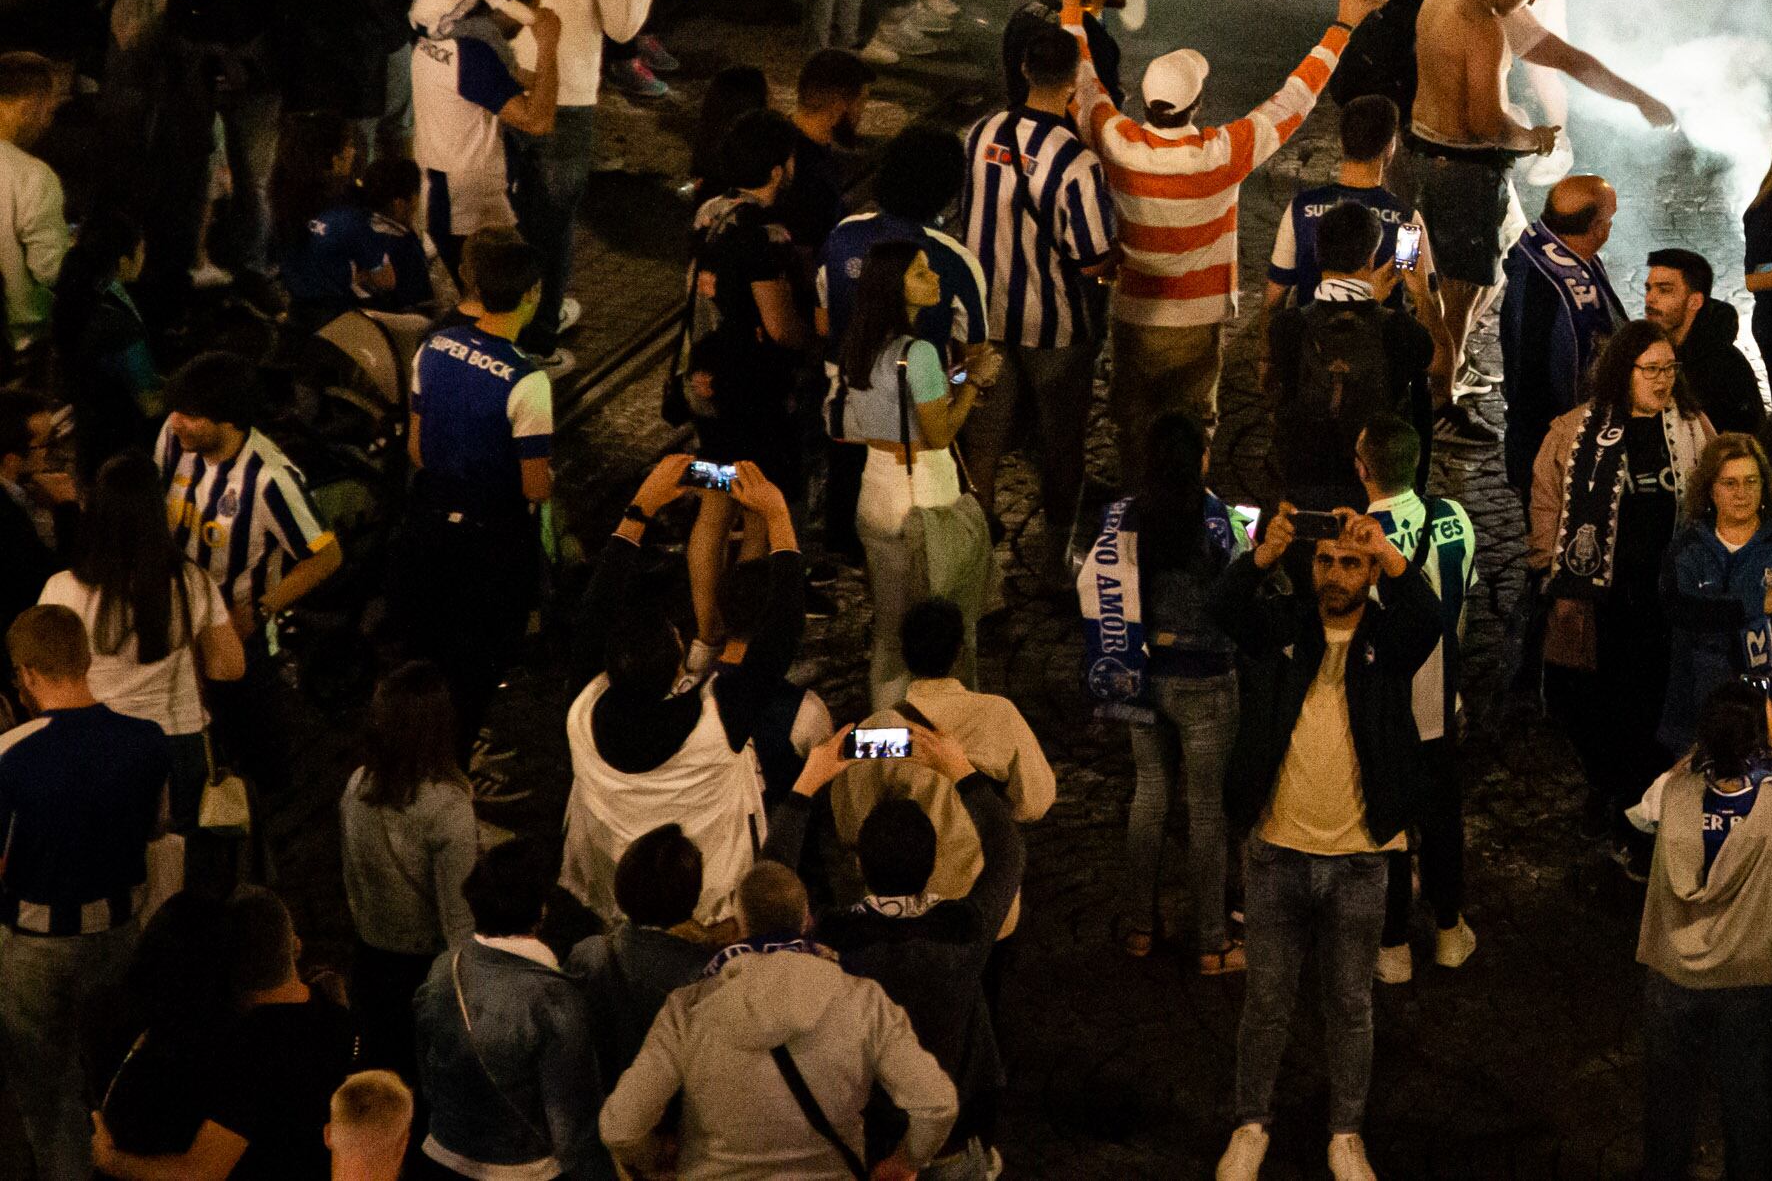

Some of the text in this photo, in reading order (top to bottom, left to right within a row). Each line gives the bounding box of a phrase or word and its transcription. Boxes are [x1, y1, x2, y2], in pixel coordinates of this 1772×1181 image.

[428, 334, 516, 383] SUPER BOCK
[1096, 574, 1130, 655] AMOR
